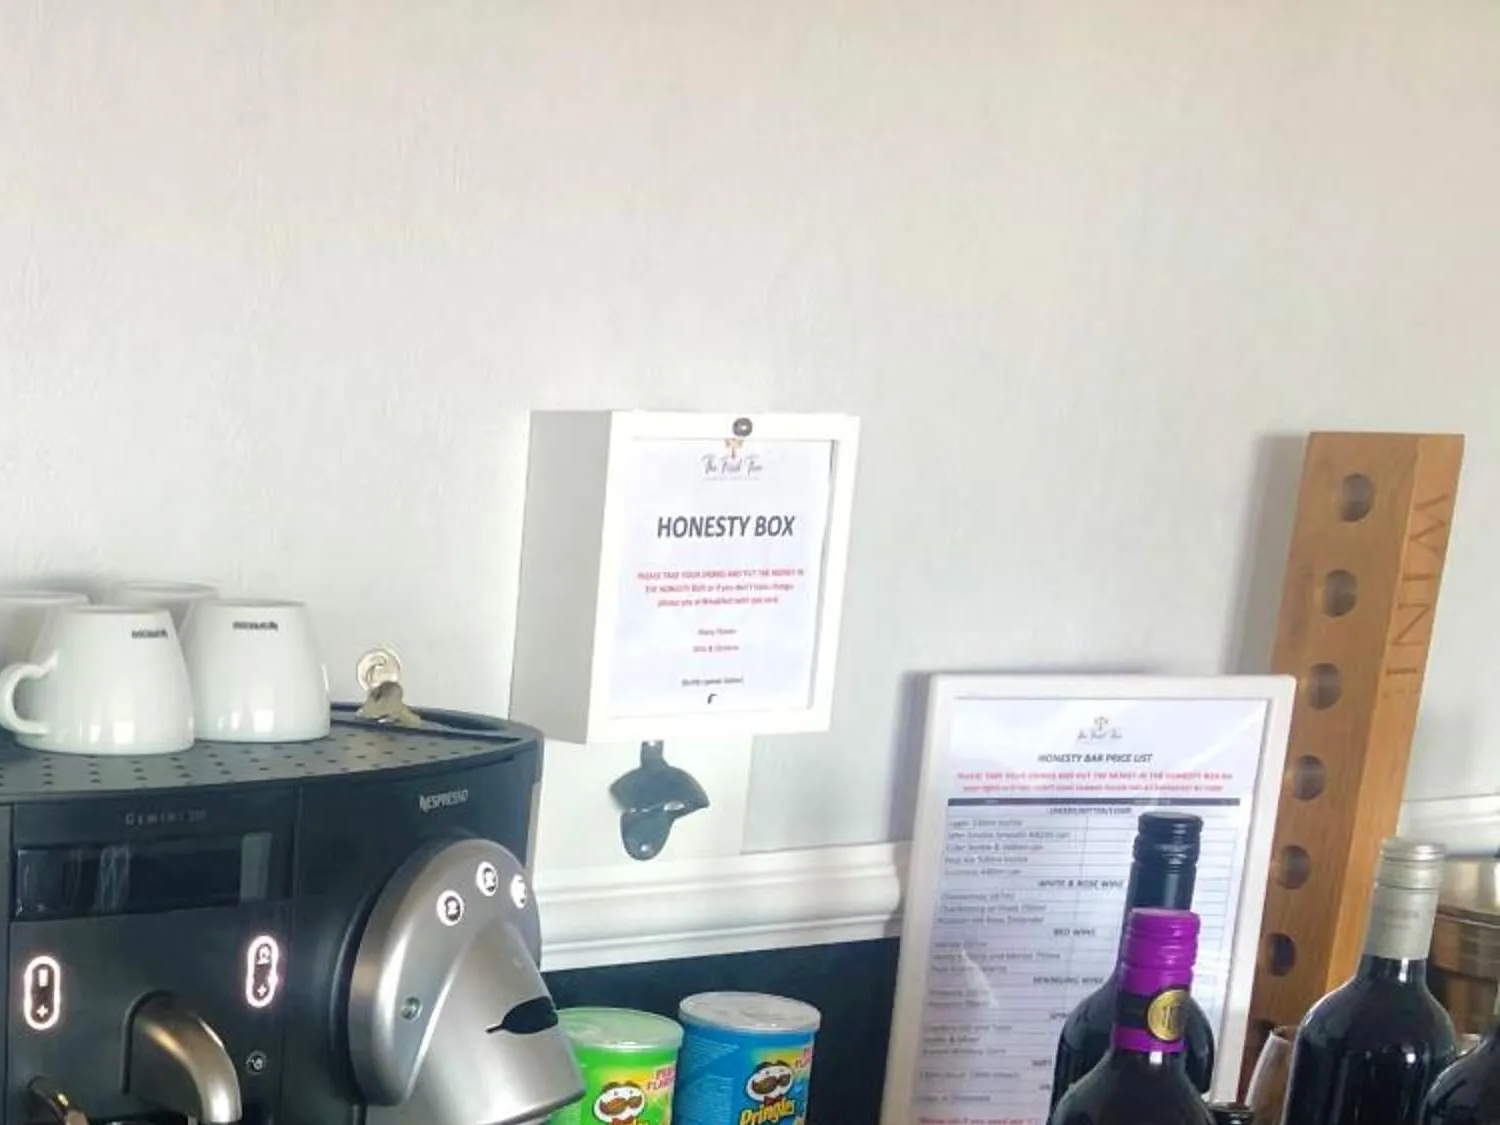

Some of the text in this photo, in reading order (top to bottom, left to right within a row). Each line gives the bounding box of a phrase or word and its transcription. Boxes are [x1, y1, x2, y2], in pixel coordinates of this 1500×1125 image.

[657, 515, 795, 538] HONESTY BOX
[1133, 752, 1154, 763] LIST
